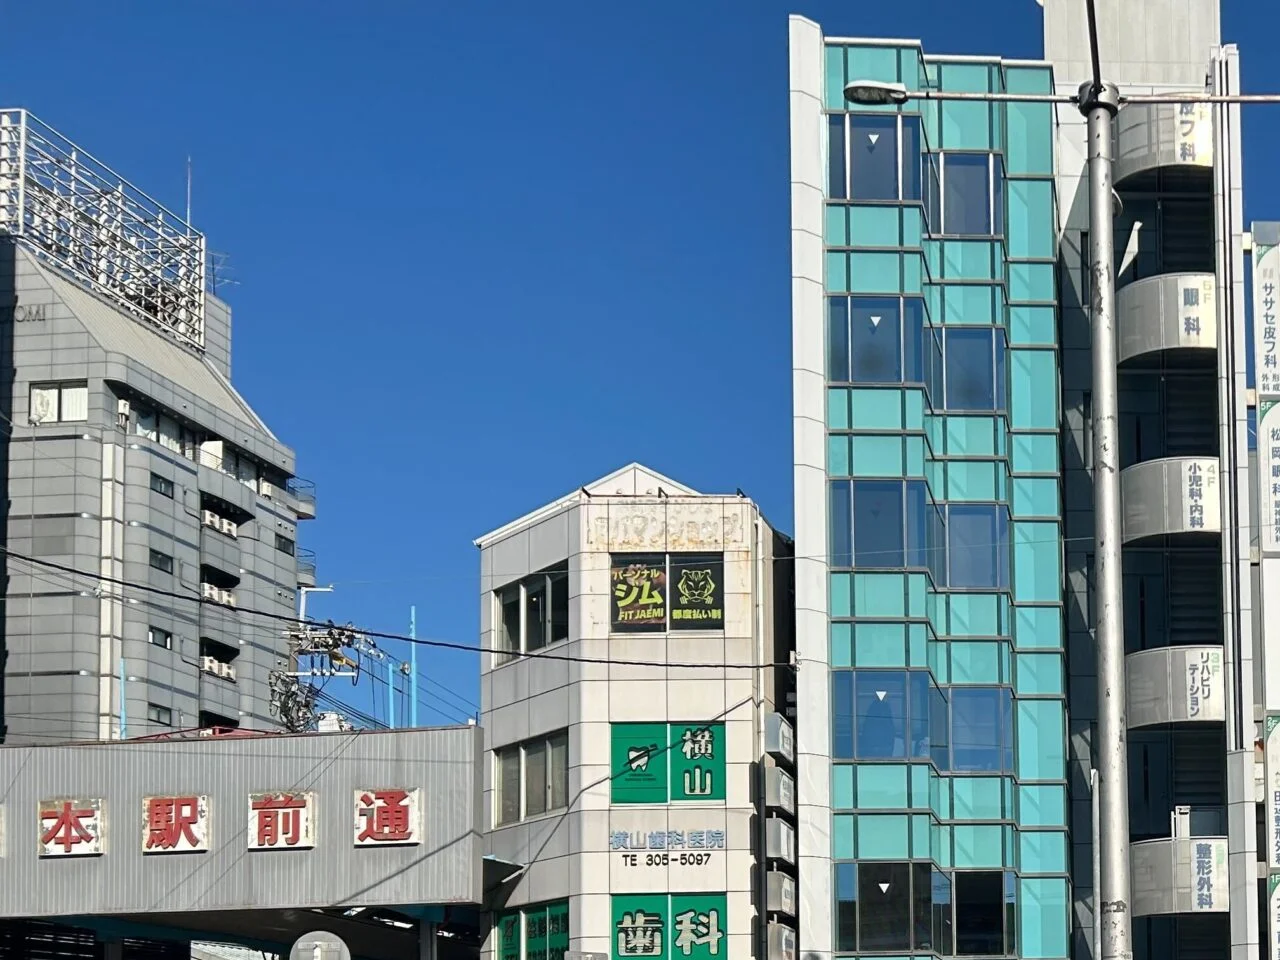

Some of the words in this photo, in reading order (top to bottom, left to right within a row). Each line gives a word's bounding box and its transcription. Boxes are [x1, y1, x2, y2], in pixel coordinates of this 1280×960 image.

[1183, 287, 1202, 337] 眼科
[1260, 401, 1272, 411] 5F
[613, 568, 660, 580] パーソナル
[614, 581, 664, 608] ジム
[618, 610, 635, 621] FIT
[635, 608, 664, 619] JAEMI
[682, 727, 716, 797] 横山
[41, 790, 413, 853] 本駅前通
[609, 830, 725, 850] 横山歯科医院
[646, 853, 711, 867] 305-5097
[1195, 843, 1214, 909] 整形外科
[1270, 874, 1280, 884] 1F
[616, 907, 725, 957] 歯科
